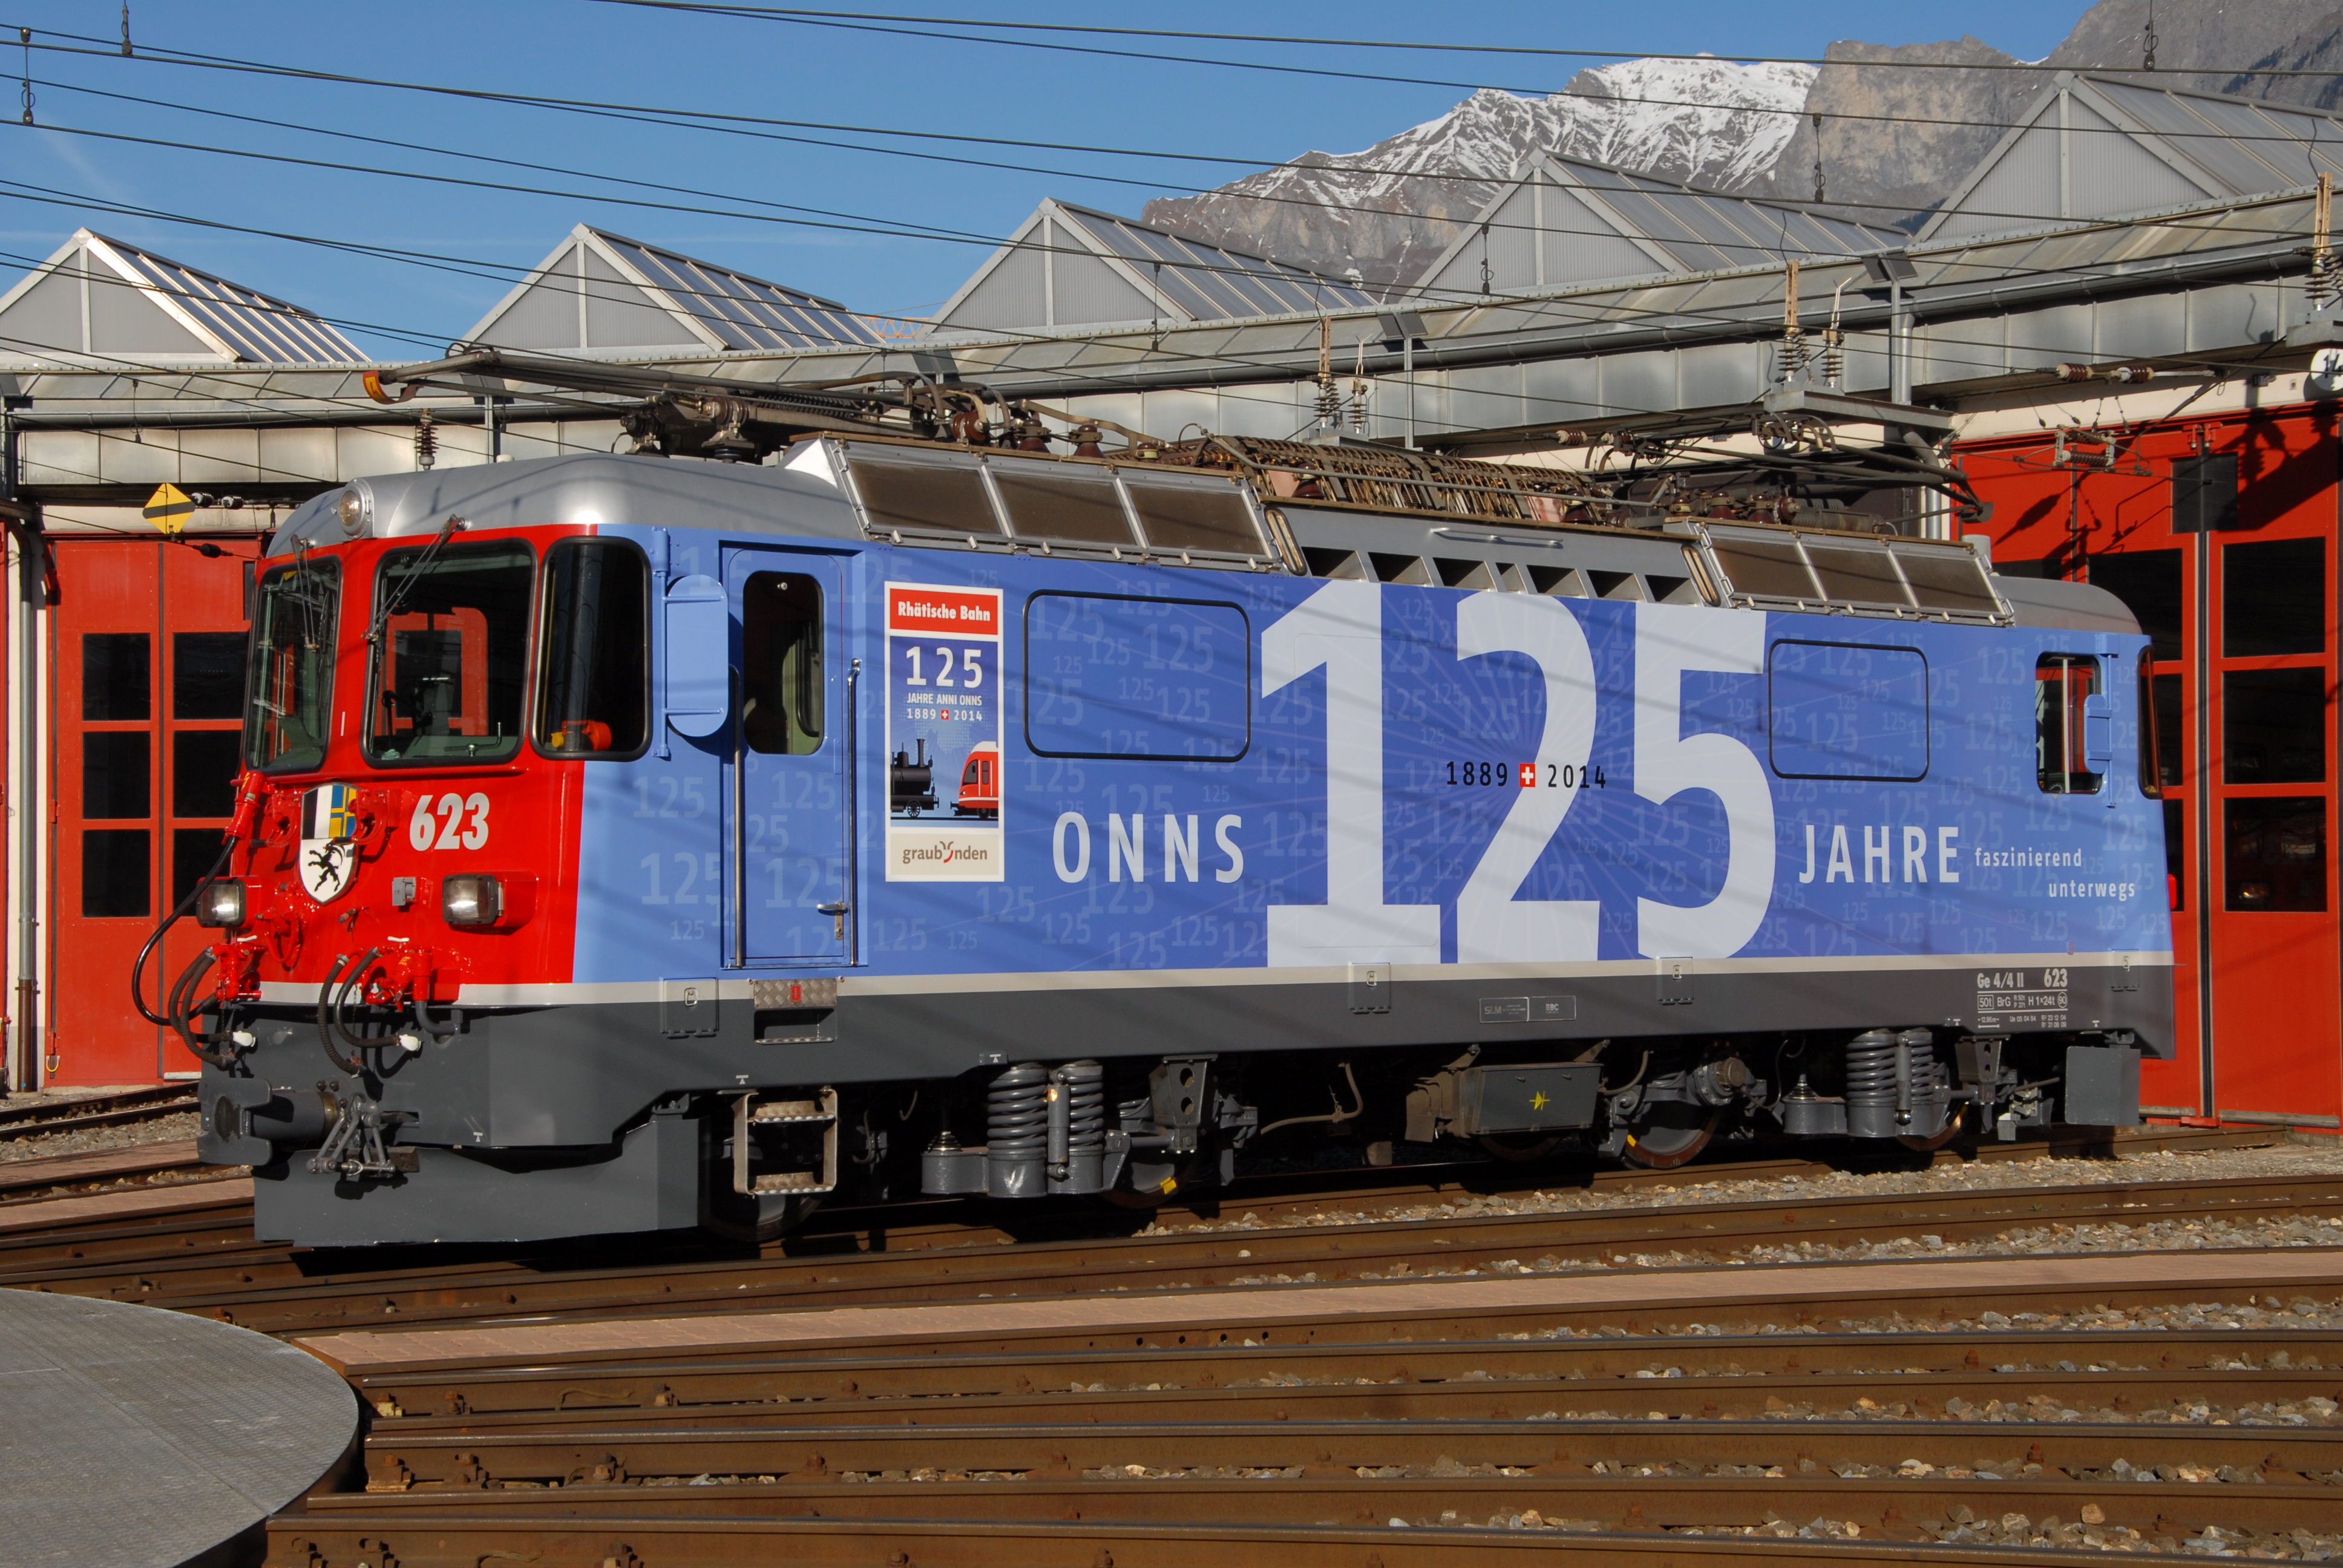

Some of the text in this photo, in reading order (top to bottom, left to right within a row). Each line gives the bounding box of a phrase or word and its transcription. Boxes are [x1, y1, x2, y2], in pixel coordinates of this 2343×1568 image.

[898, 601, 991, 621] Rhätische Bahn
[1088, 638, 1130, 665] 125
[1142, 623, 1214, 672] 125
[906, 646, 983, 688] 125
[1054, 655, 1083, 674] 125
[906, 693, 982, 706] JAHRE ANNI ONNS
[1007, 678, 1084, 726] 125
[1118, 677, 1154, 701] 125
[1157, 686, 1210, 722] 125
[907, 708, 983, 721] 1889 2014
[1806, 712, 1858, 752] 125
[1024, 756, 1085, 792] 125
[1257, 747, 1310, 783] 125
[1262, 580, 1776, 967] 125
[1446, 761, 1606, 789] 1889 2014
[633, 776, 704, 818] 125
[772, 770, 836, 809] 125
[1202, 785, 1230, 802] 125
[409, 792, 490, 851] 623
[1052, 811, 1244, 883] ONNS
[1799, 825, 1960, 884] JAHRE
[1975, 848, 2082, 867] faszinierend
[977, 886, 1035, 923] 125
[2049, 881, 2135, 900] unterwegs
[670, 920, 704, 940] 125
[873, 918, 926, 951] 125
[947, 931, 978, 950] 125
[1041, 913, 1091, 944] 125
[1172, 916, 1218, 946] 125
[1109, 932, 1166, 969] 125
[1977, 972, 2024, 988] Ge 4/4 II
[2044, 969, 2068, 987] 623
[1979, 997, 2011, 1008] 50t BrG
[2028, 996, 2034, 1005] H
